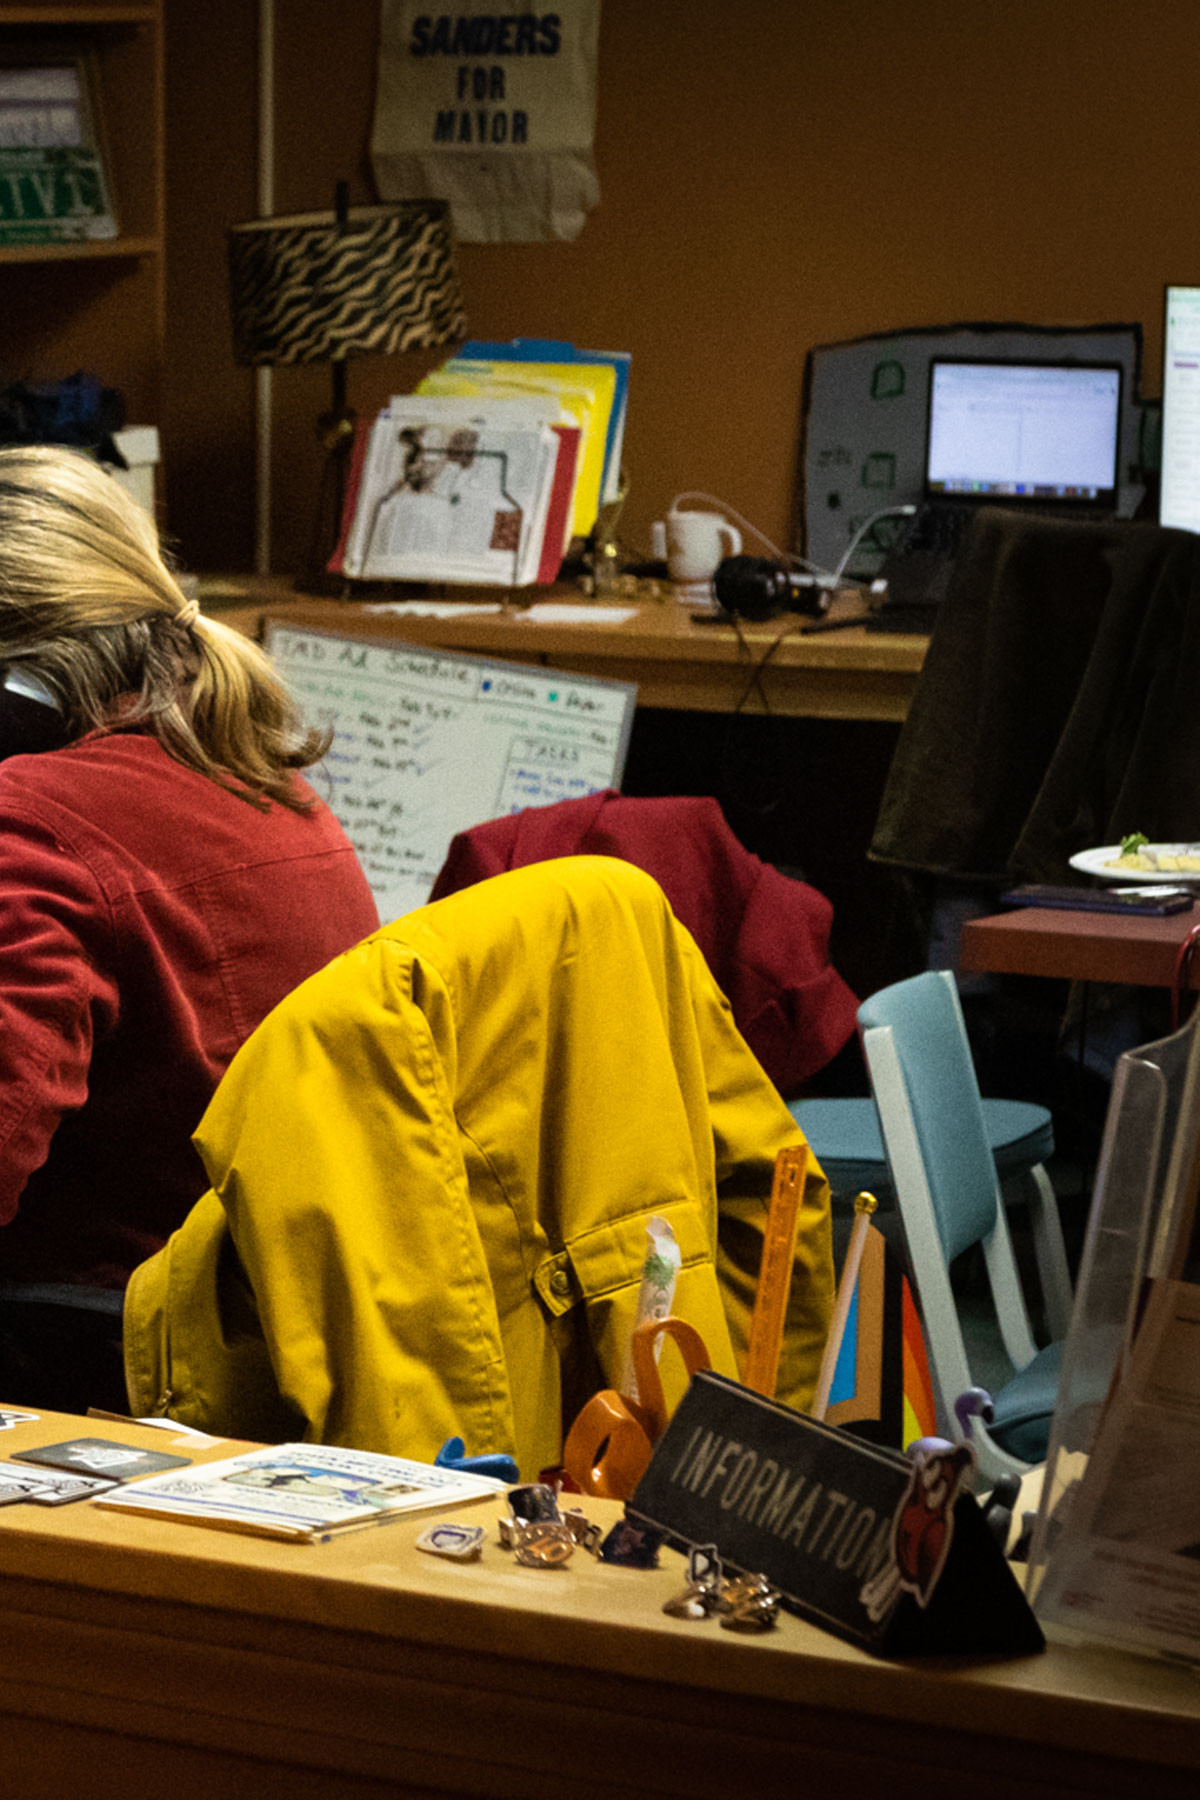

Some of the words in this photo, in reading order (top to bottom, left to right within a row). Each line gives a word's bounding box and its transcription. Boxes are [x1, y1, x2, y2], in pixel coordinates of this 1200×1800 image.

[409, 14, 560, 57] SANDERS
[456, 66, 505, 100] FOR
[433, 110, 528, 143] MAYOR
[671, 1425, 892, 1581] INFORMATION
